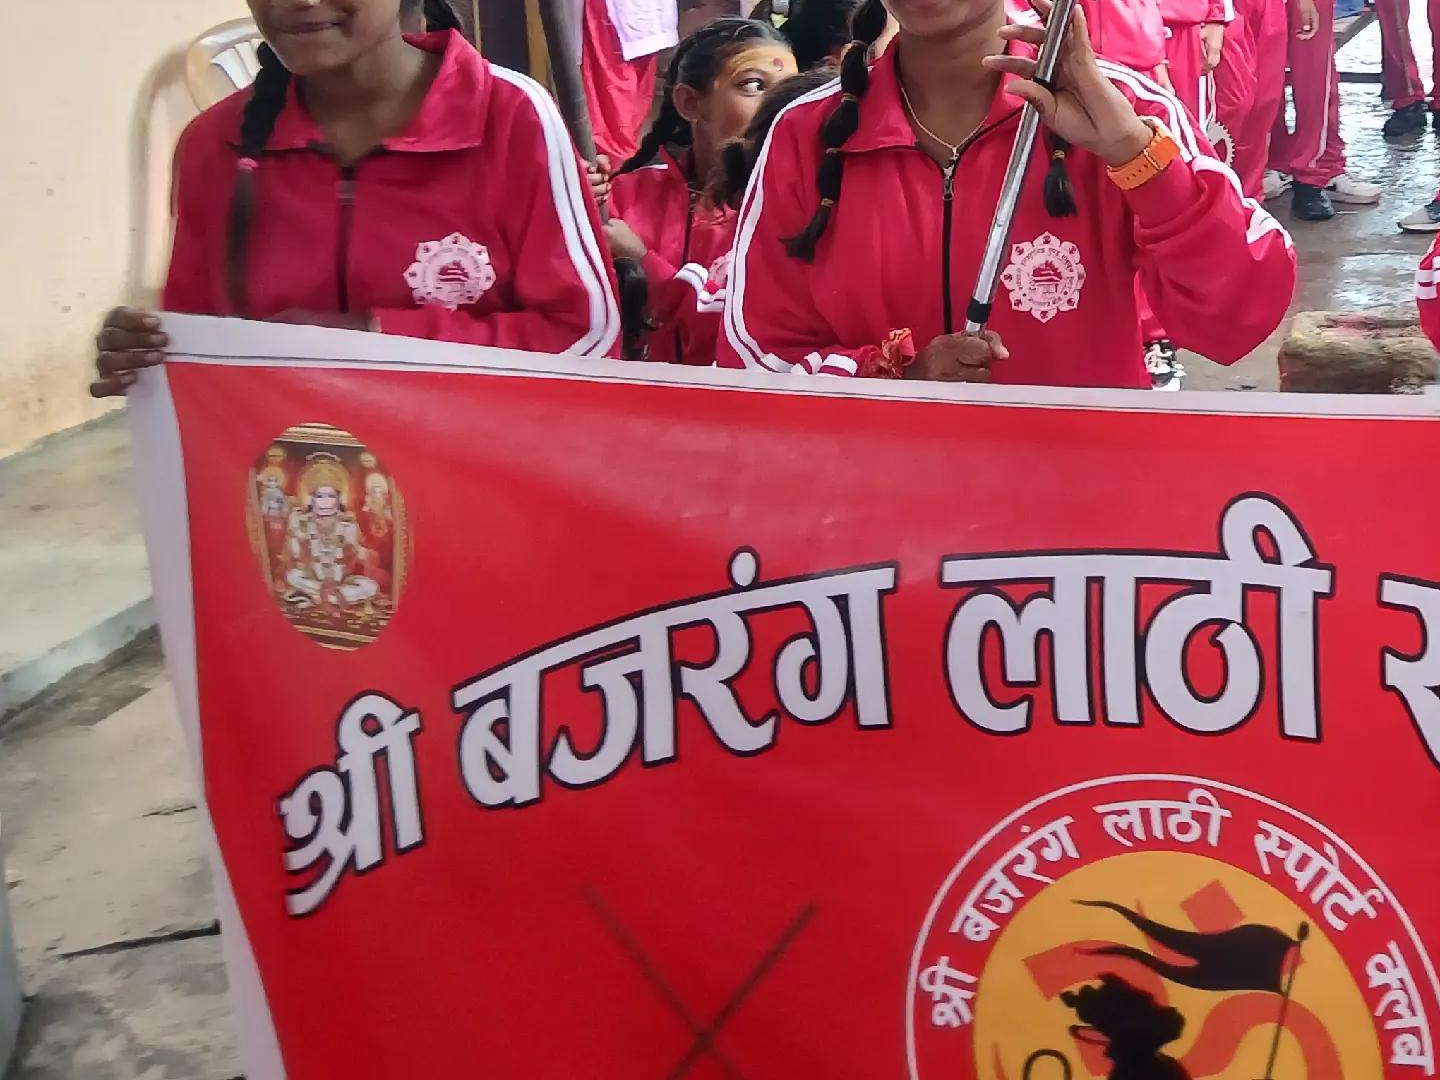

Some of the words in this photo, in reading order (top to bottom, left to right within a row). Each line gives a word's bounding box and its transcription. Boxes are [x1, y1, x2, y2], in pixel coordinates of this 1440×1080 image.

[280, 691, 424, 918] श्री
[452, 550, 897, 809] बजरंग
[940, 494, 1334, 742] लाठी
[918, 955, 979, 1028] श्री
[949, 815, 1081, 942] बजरंग
[1092, 787, 1232, 847] लाठी
[1253, 819, 1385, 931] स्पोर्ट
[1364, 941, 1437, 1076] क्लब
